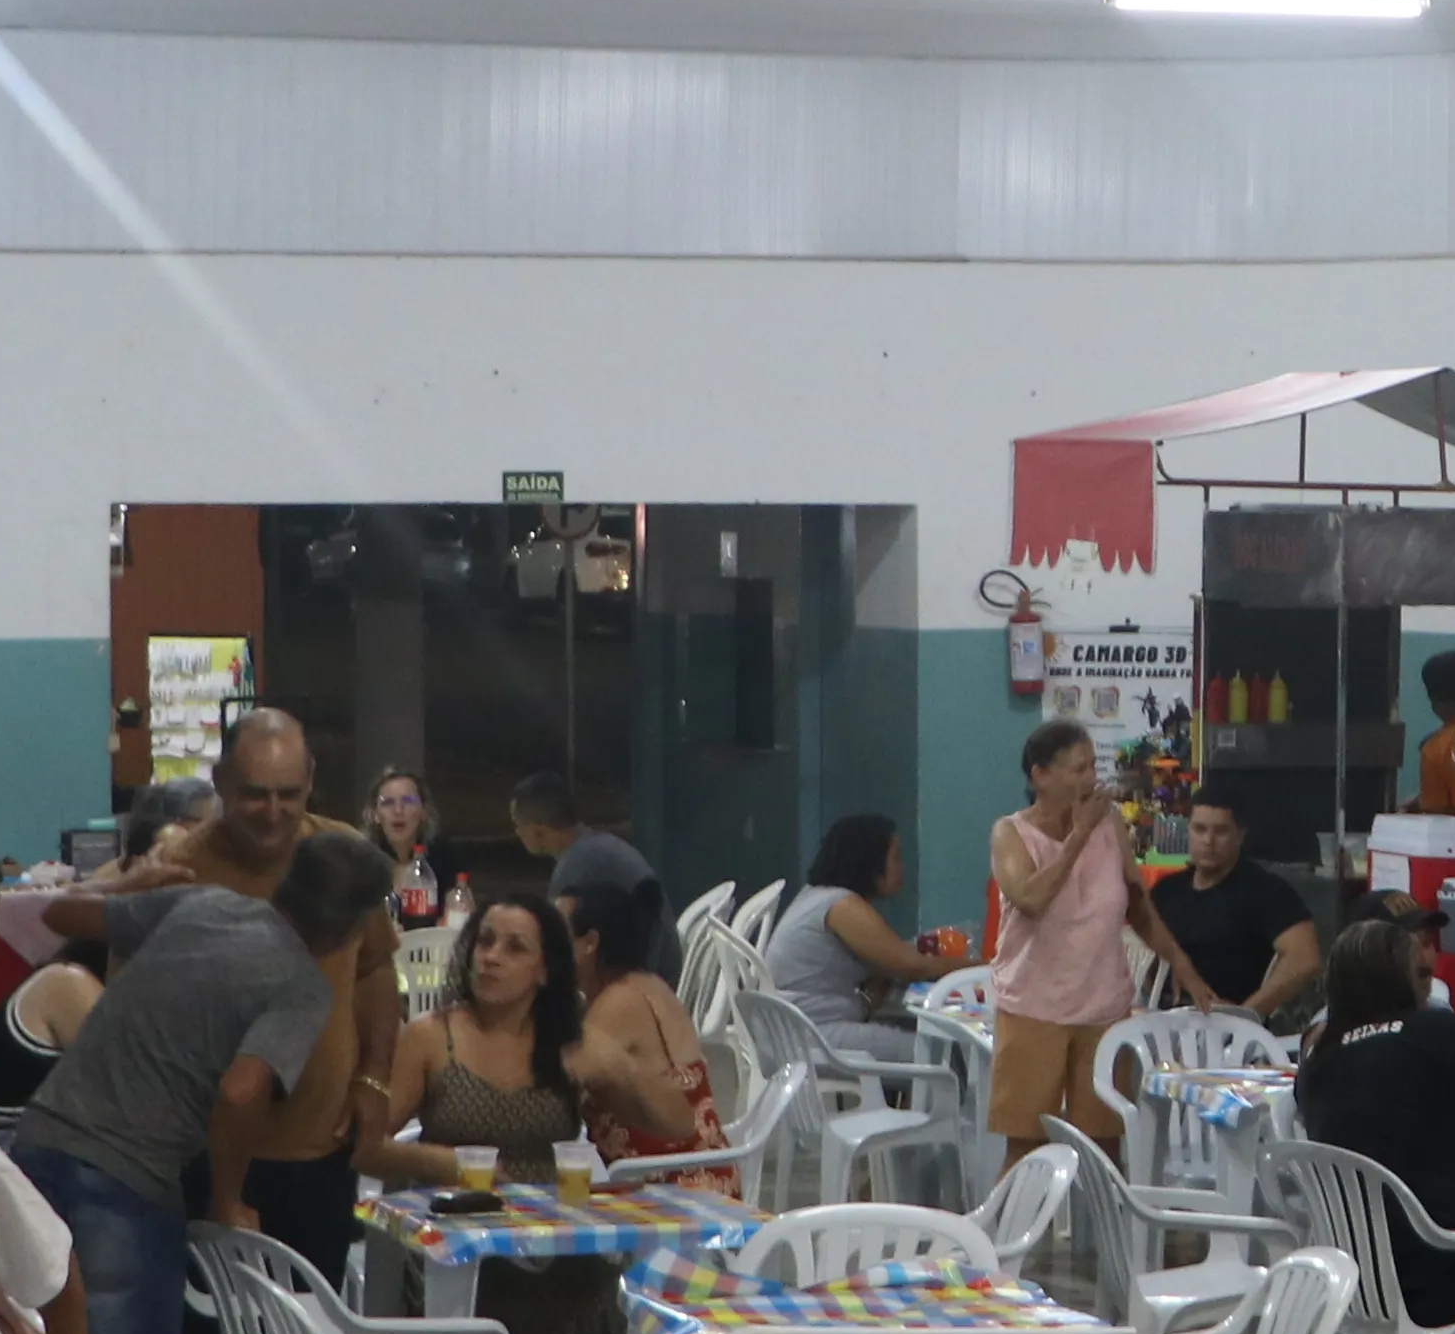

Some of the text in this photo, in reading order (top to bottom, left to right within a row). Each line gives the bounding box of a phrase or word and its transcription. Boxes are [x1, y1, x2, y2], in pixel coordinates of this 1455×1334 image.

[507, 473, 560, 491] SAÍDA
[1073, 645, 1187, 663] CAMARGO 3D
[1341, 1020, 1404, 1045] SEIXAS
